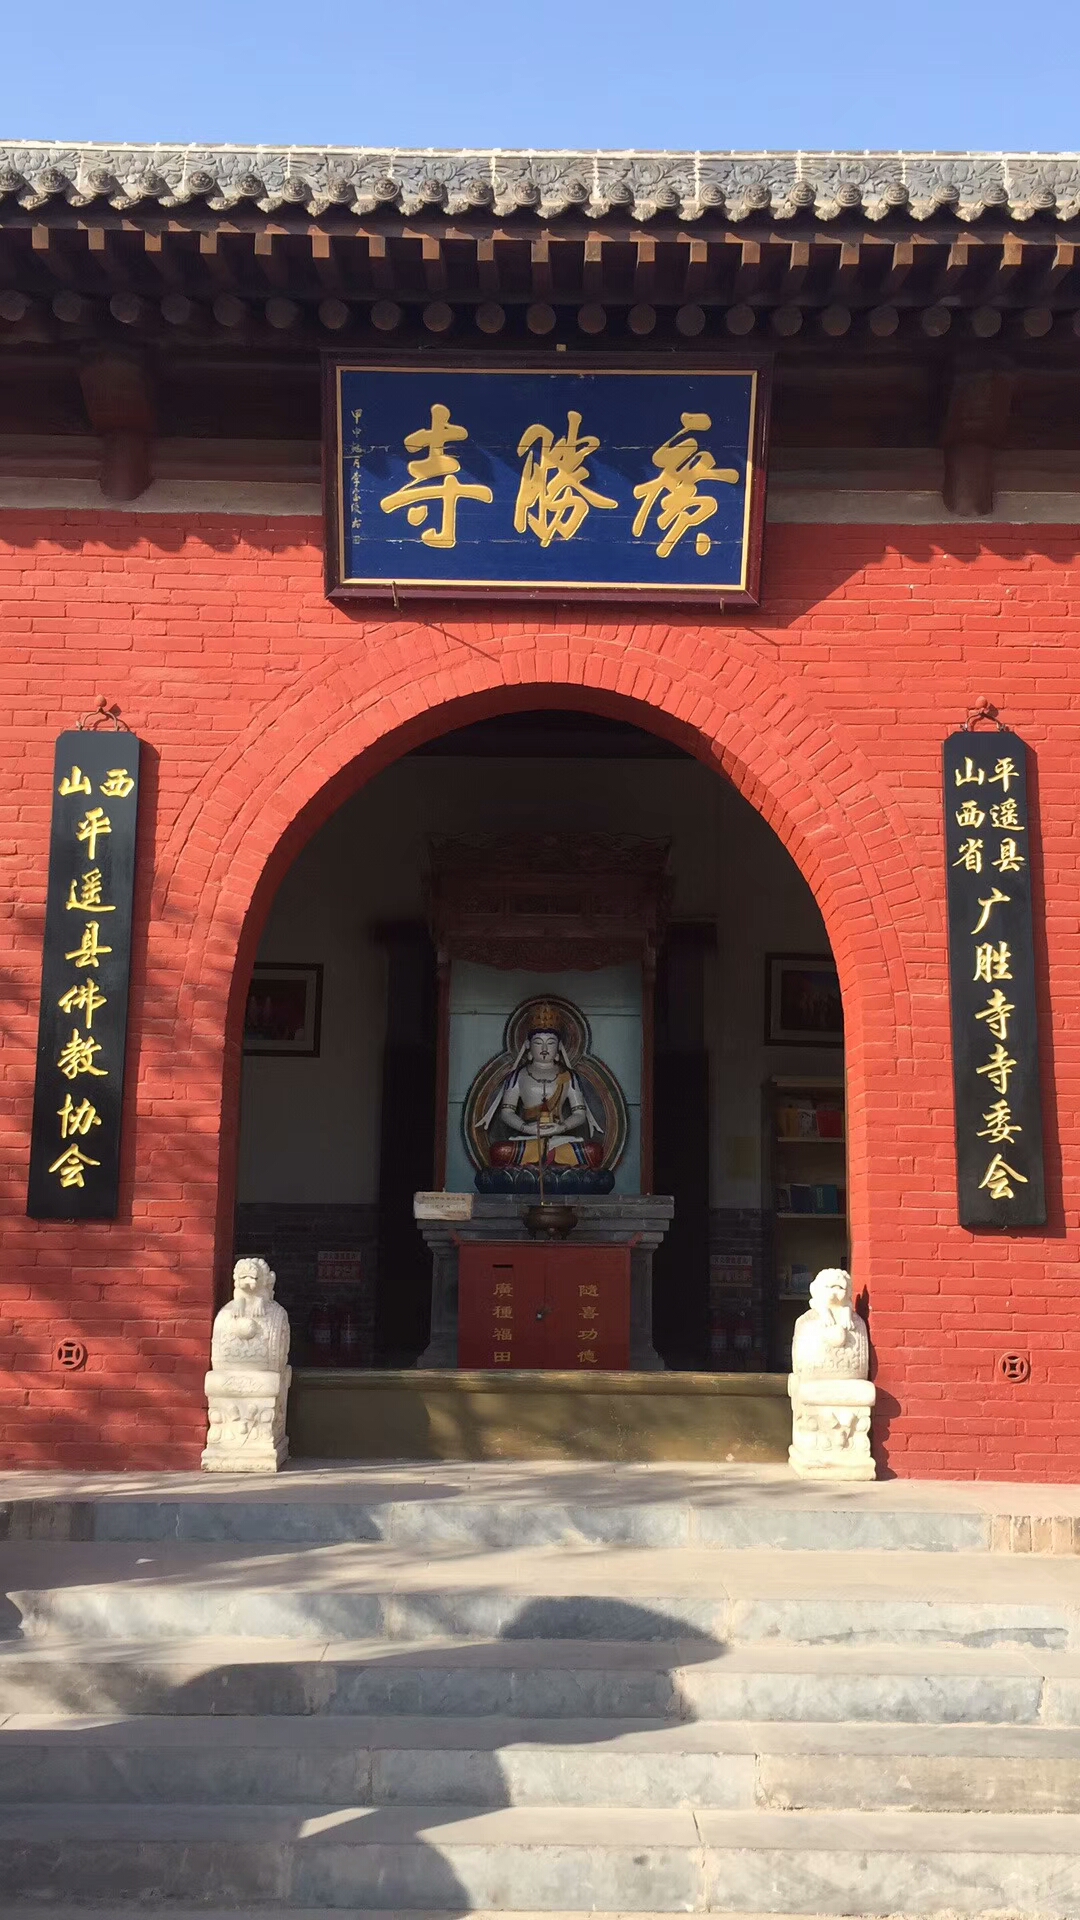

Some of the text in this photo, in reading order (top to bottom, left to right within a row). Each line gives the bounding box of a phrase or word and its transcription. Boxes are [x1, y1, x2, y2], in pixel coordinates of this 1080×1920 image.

[952, 757, 985, 874] 山西省
[987, 757, 1027, 873] 平遥县
[48, 807, 116, 1189] 平遥县佛教协会
[971, 887, 1029, 1200] 广胜寺寺委会
